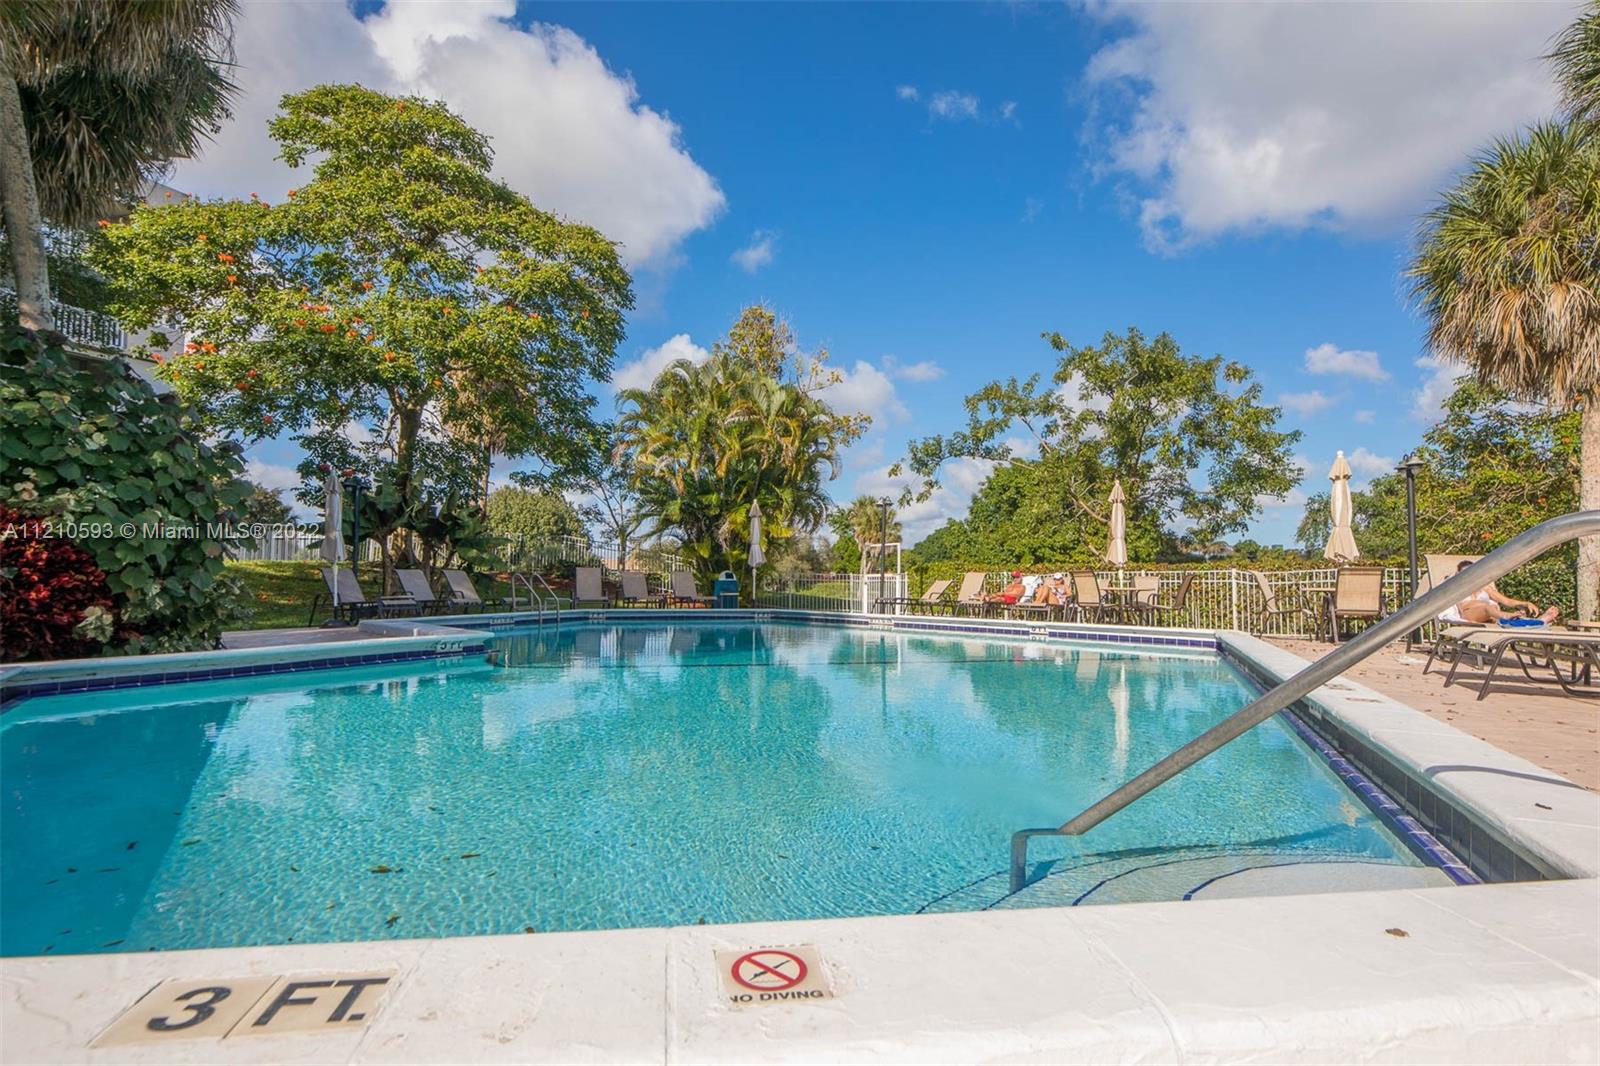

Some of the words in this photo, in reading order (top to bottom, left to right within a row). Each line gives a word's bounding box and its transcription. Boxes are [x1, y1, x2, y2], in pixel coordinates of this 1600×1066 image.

[146, 986, 232, 1031] 3
[251, 977, 391, 1027] FT.
[760, 990, 824, 1001] DIVING
